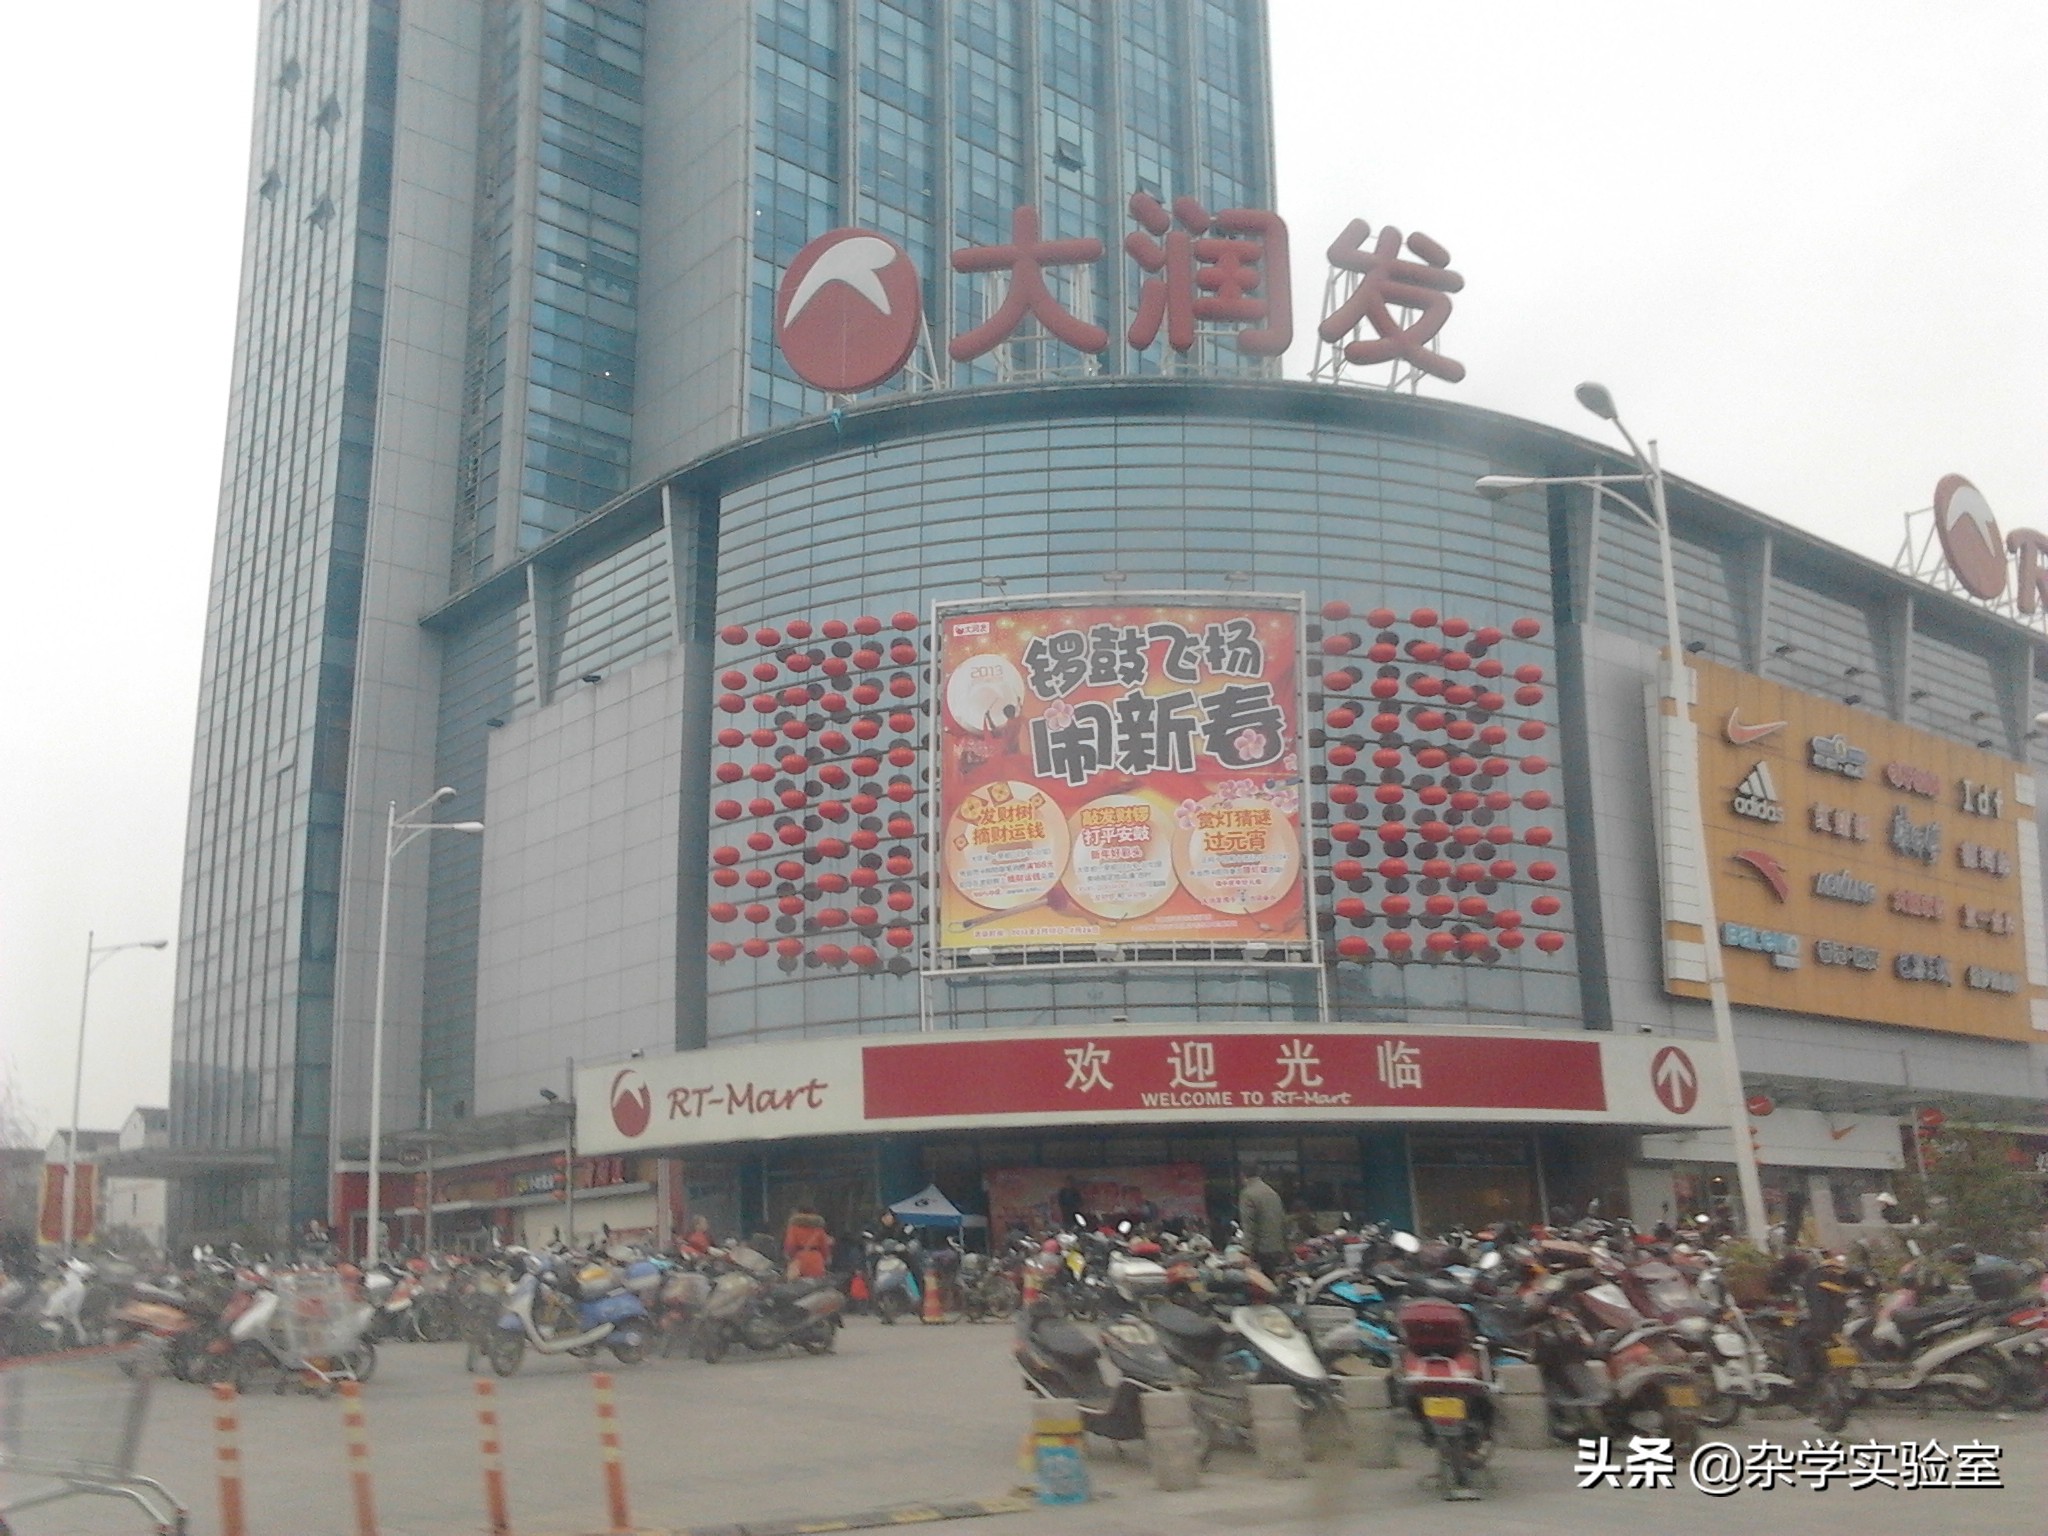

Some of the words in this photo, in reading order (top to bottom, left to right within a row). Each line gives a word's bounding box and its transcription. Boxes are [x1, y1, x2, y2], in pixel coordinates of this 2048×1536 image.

[949, 193, 1466, 384] 大润发
[1024, 617, 1263, 700] 锣鼓飞扬
[970, 664, 1003, 679] 2013
[1030, 683, 1286, 786] 闹新春
[980, 804, 1033, 826] 发财树
[1196, 809, 1273, 830] 赏灯猜谜
[1734, 796, 1784, 823] adidas
[1082, 825, 1150, 846] 打平安鼓
[1203, 830, 1267, 852] 过元宵
[1064, 1039, 1422, 1092] 欢迎光临
[667, 1078, 828, 1120] RT-Mart
[1140, 1091, 1233, 1108] WELCOME
[1240, 1091, 1264, 1105] TO
[1271, 1090, 1352, 1105] RT-Mart
